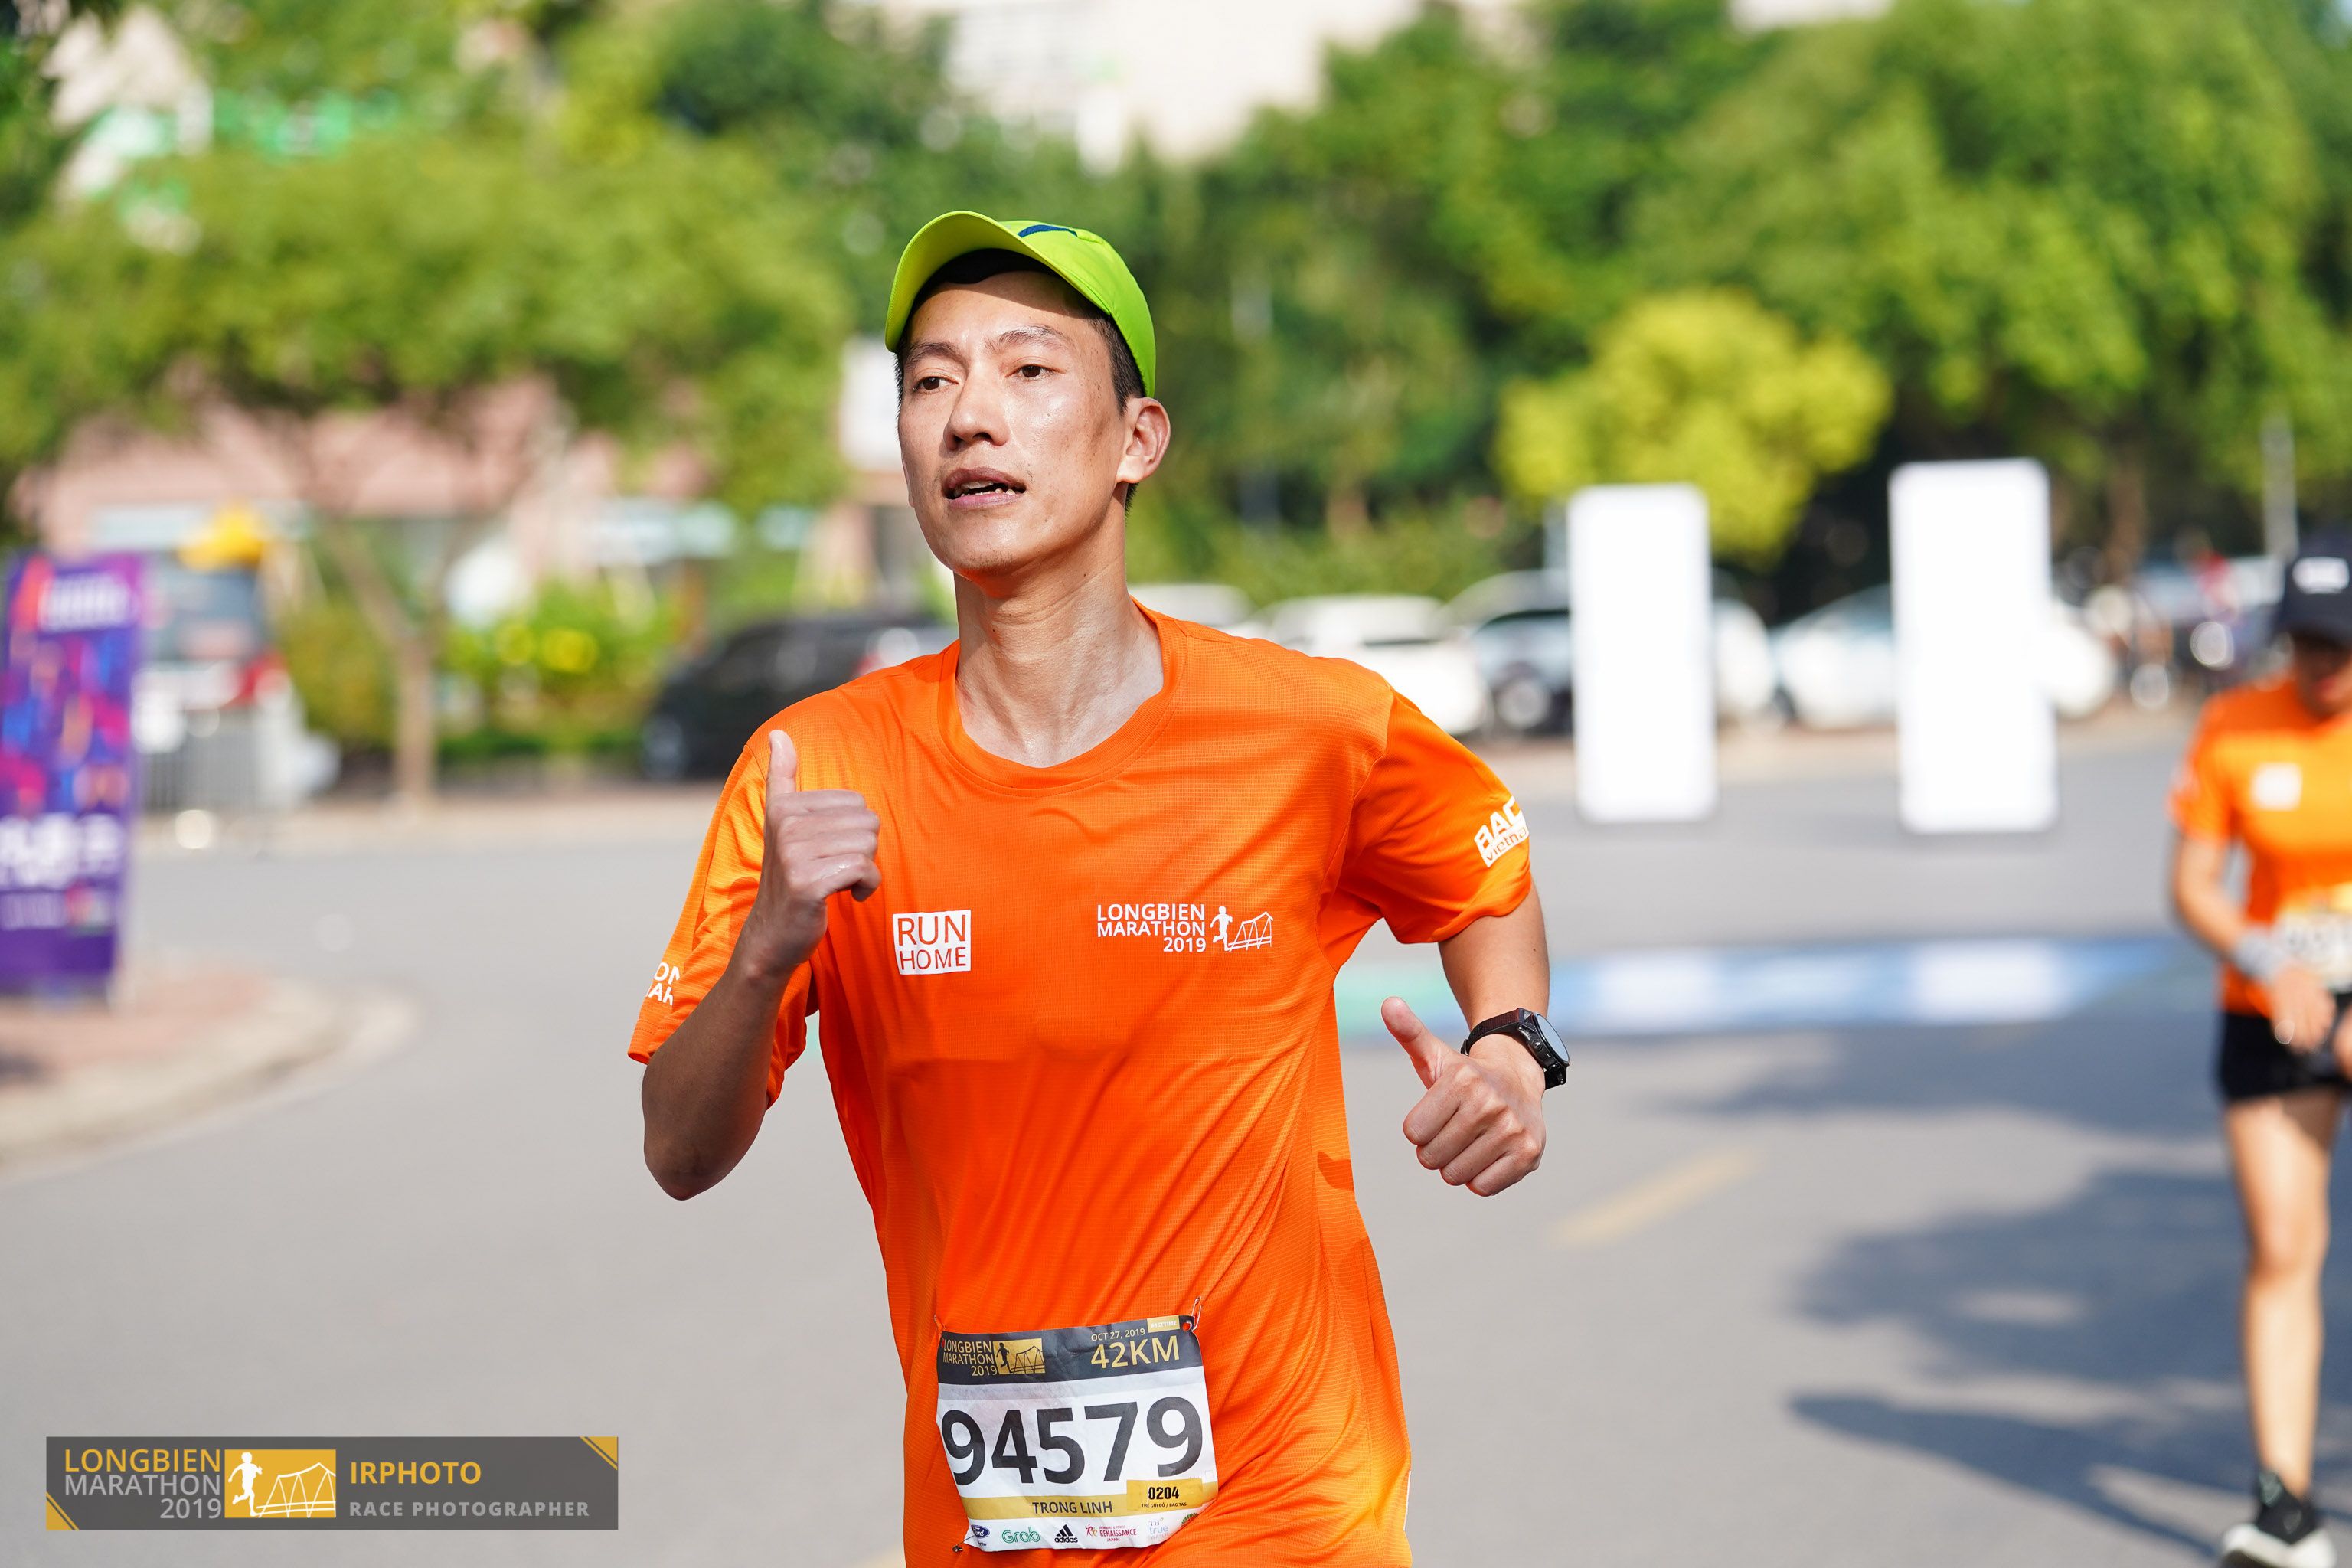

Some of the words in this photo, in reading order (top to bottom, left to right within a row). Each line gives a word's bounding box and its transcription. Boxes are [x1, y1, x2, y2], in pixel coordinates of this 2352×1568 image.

[1096, 903, 1205, 921] LONGBIEN
[897, 914, 966, 946] RUN
[1096, 920, 1205, 938] MARATHON
[1163, 937, 1207, 953] 2019
[899, 946, 966, 970] HOME
[1090, 1332, 1109, 1342] OCT
[1110, 1331, 1122, 1340] 27,
[1125, 1328, 1145, 1338] 2019
[943, 1339, 993, 1354] LONGBIEN
[1090, 1334, 1180, 1369] 42KM
[942, 1351, 995, 1365] MARATHON
[971, 1365, 998, 1377] 2019
[941, 1396, 1204, 1486] 94579
[1148, 1486, 1180, 1500] 0204
[1032, 1501, 1077, 1514] TRONG
[1080, 1501, 1113, 1514] LINH
[1001, 1527, 1040, 1544] Grab
[1054, 1535, 1079, 1544] adidas
[1099, 1528, 1137, 1537] RENAISSANCE
